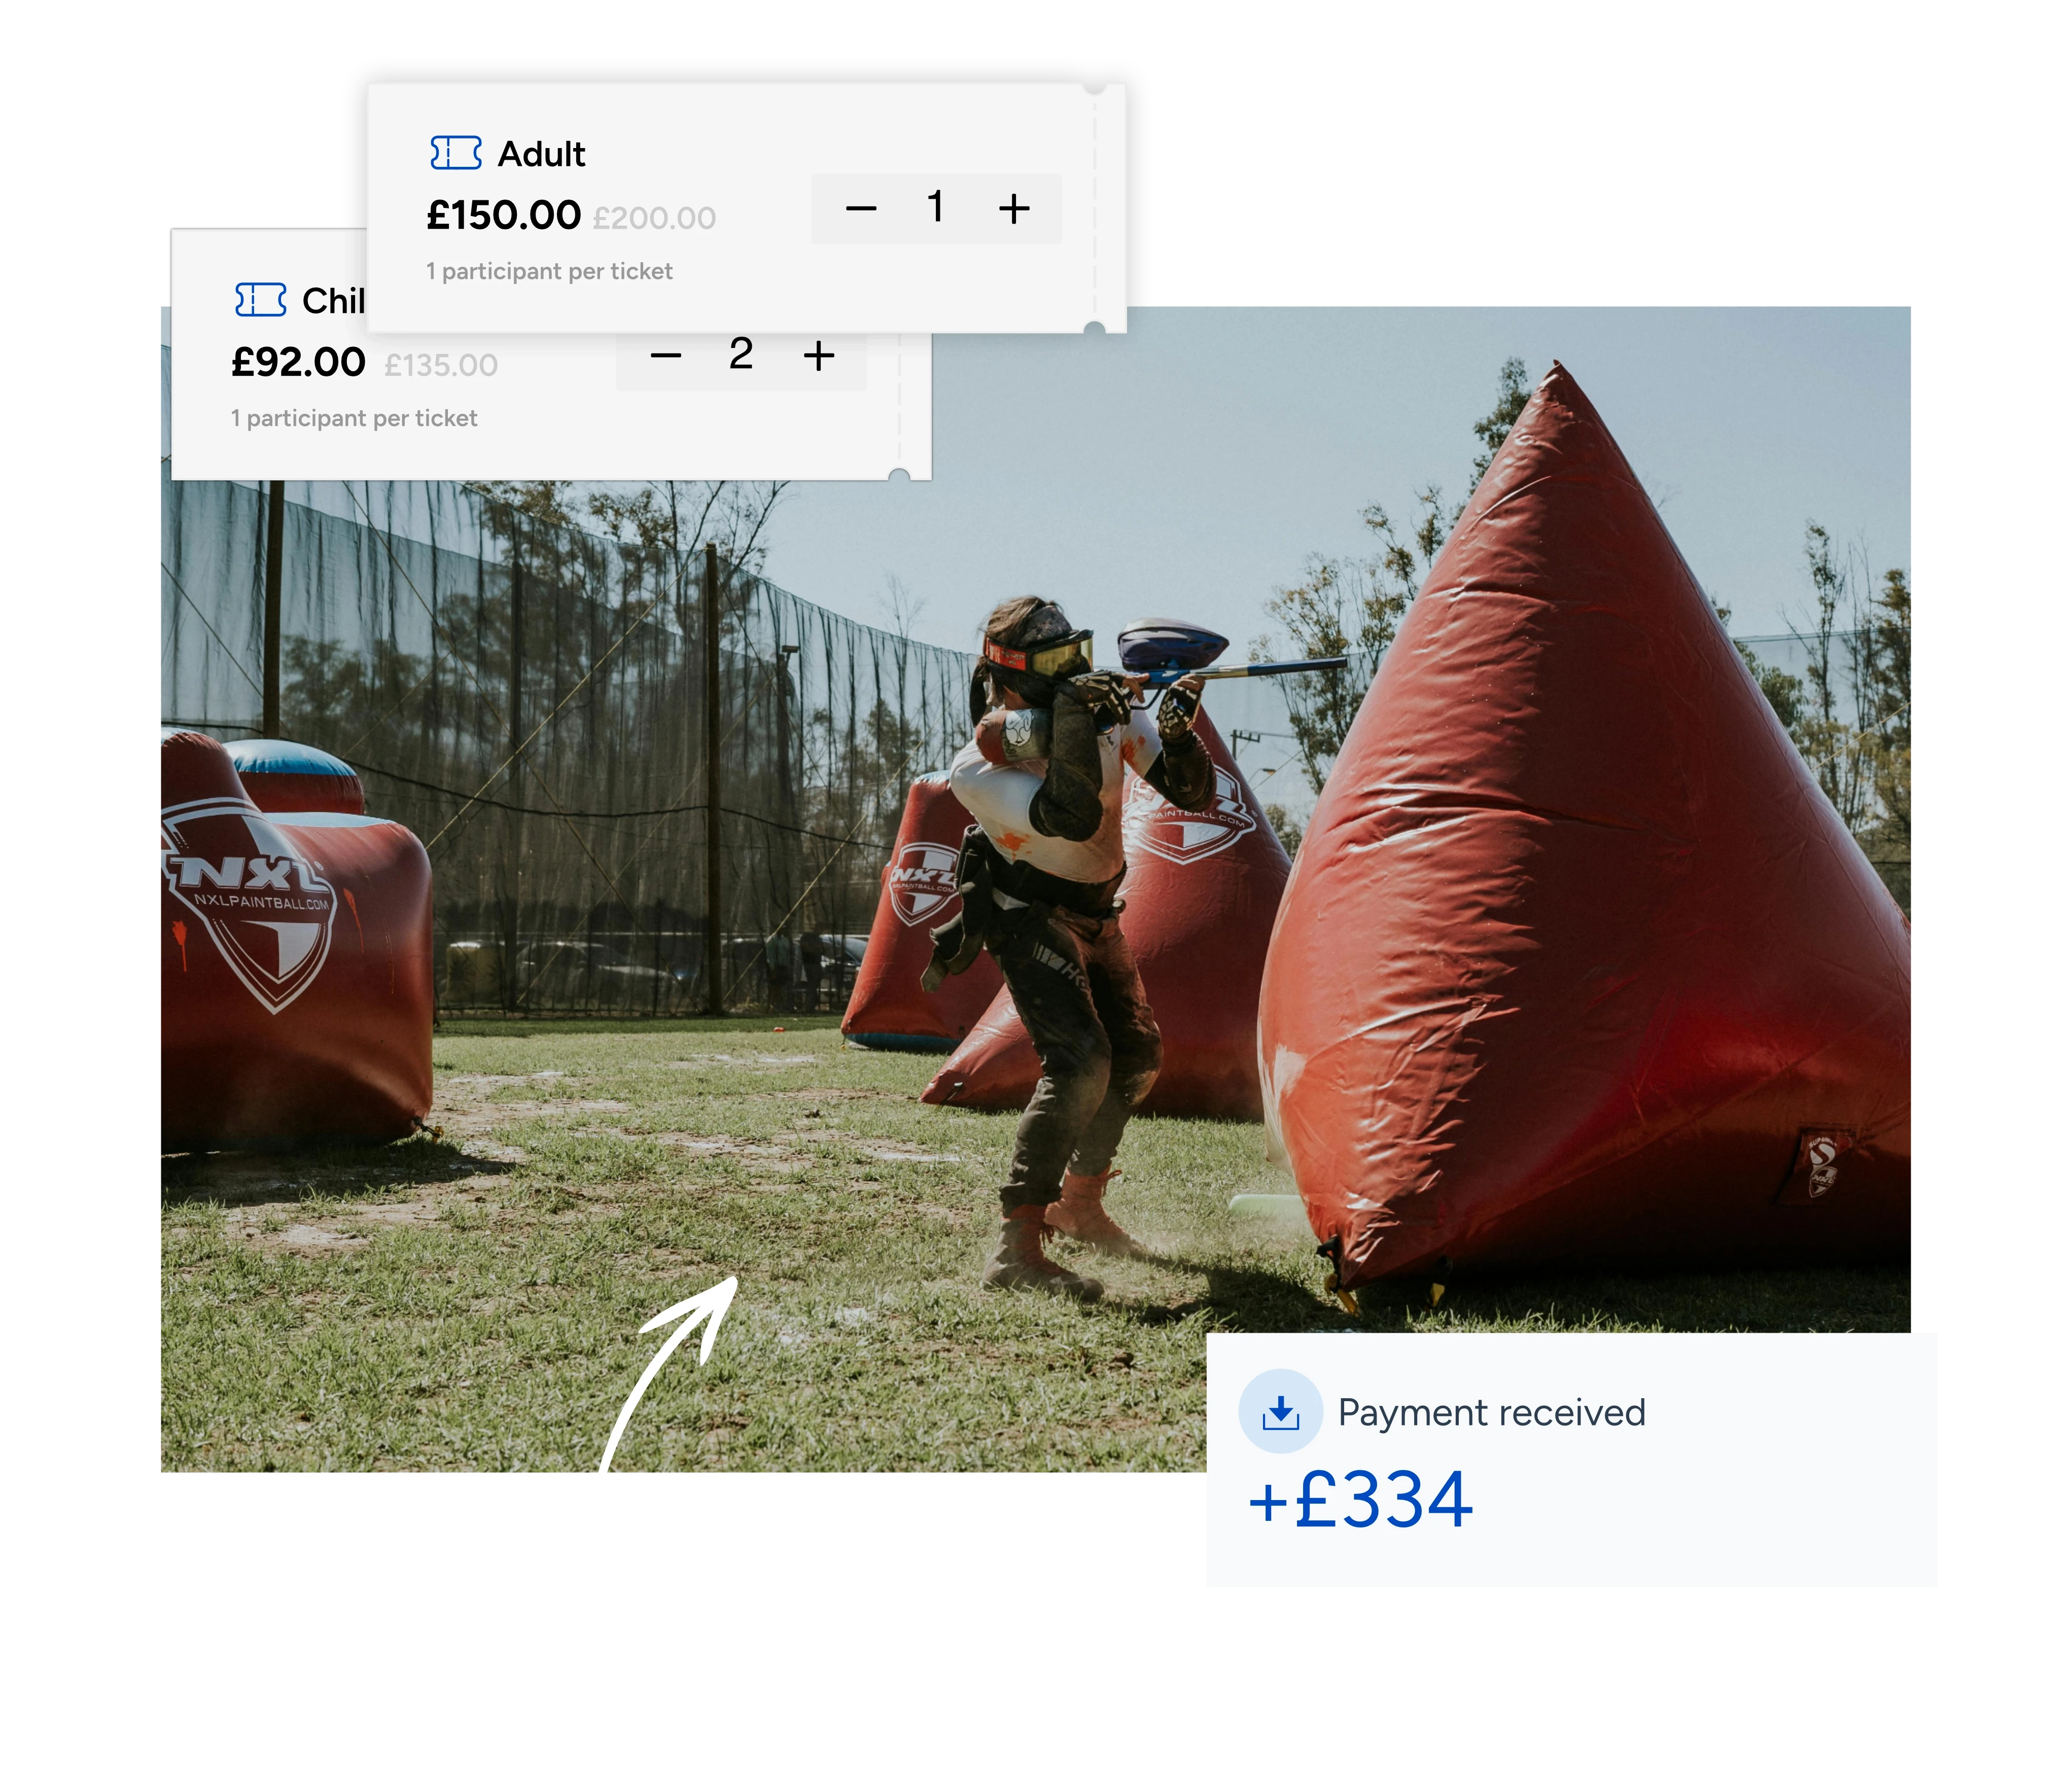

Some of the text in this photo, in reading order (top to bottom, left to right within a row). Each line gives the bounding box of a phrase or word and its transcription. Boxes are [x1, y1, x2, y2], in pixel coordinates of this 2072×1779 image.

[170, 857, 330, 893] NXL
[892, 868, 956, 885] NXL
[194, 894, 330, 910] NXLPAINTBALL.COM
